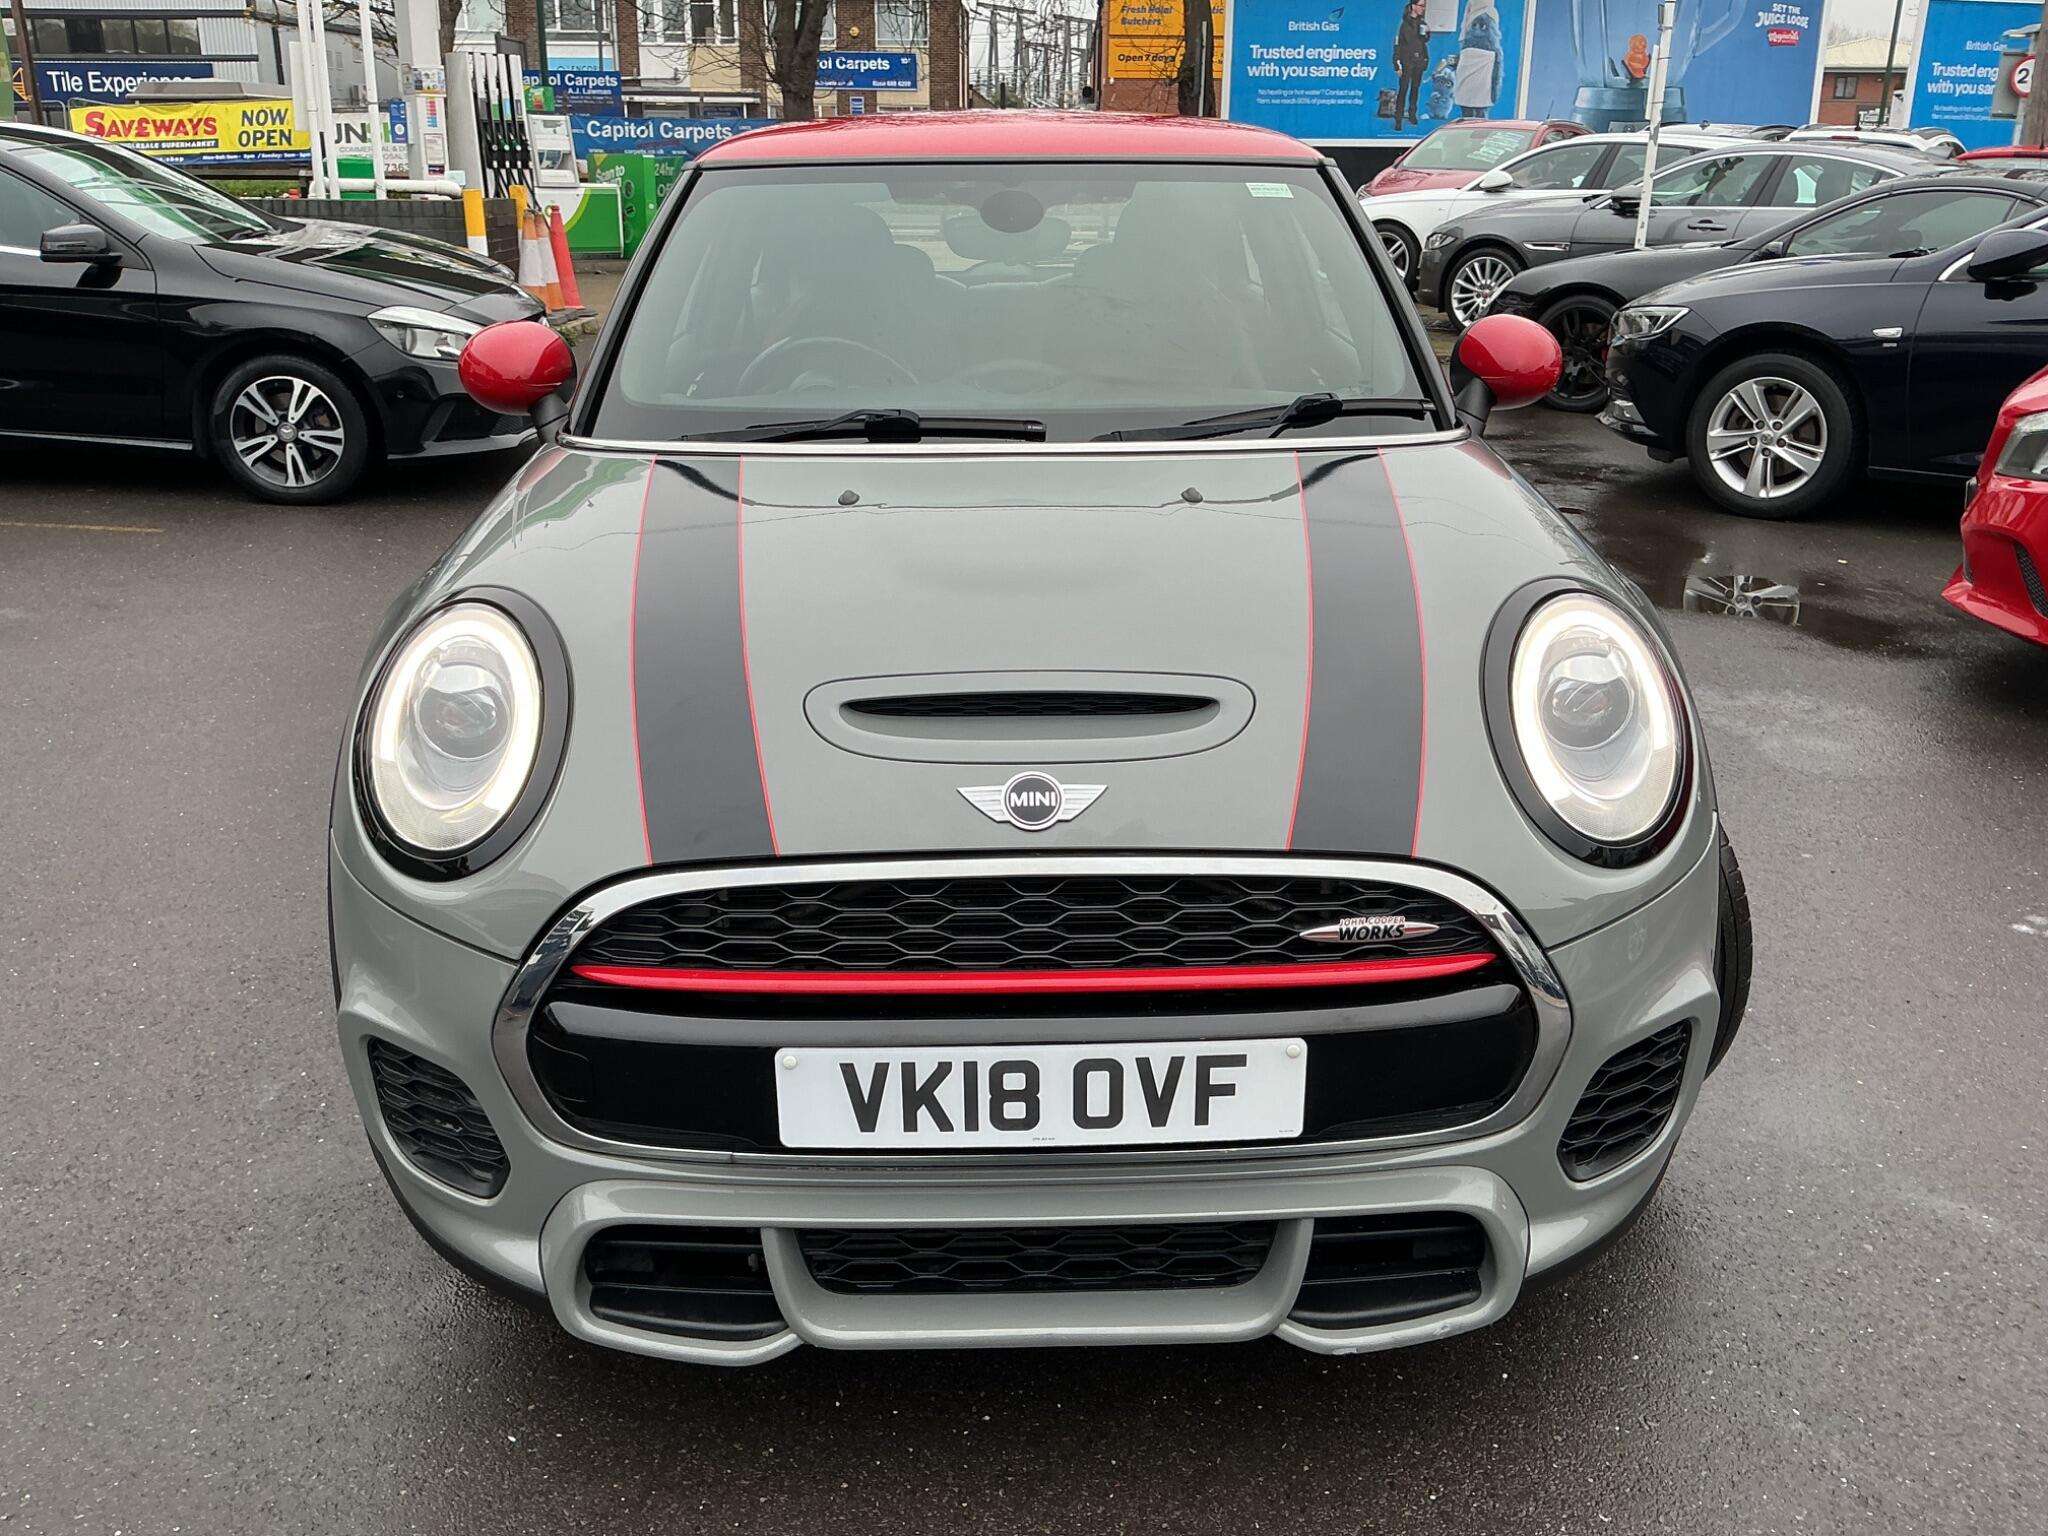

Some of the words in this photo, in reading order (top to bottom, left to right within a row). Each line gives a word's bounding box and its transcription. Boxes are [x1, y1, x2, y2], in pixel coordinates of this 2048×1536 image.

[1773, 3, 1787, 13] SET
[1788, 5, 1801, 14] THE
[1288, 21, 1321, 32] British
[1321, 21, 1340, 32] Gas
[1755, 11, 1786, 27] JUICE
[1250, 44, 1304, 60] Trusted
[1306, 44, 1377, 62] engineers
[1966, 40, 1992, 51] British
[836, 57, 890, 73] Carpets
[1117, 53, 1143, 62] Open
[1247, 61, 1279, 78] with
[1281, 65, 1308, 80] you
[1309, 65, 1349, 78] same
[1350, 63, 1377, 80] day
[1932, 62, 1977, 78] Trusted
[1977, 65, 2000, 82] eng
[2017, 68, 2030, 84] 2
[46, 71, 83, 92] Tile
[564, 73, 618, 89] Carpets
[1927, 79, 1954, 94] with
[1955, 83, 1977, 97] you
[241, 108, 289, 127] NOW
[238, 129, 293, 147] OPEN
[587, 120, 654, 142] Capitol
[659, 121, 732, 143] Carpets
[161, 140, 216, 149] SUPERMARKET
[1010, 791, 1057, 807] MINI
[1339, 918, 1365, 927] JOHN
[1367, 916, 1405, 925] COOPER
[1338, 925, 1404, 941] WORKS
[839, 1060, 1039, 1133] VK18
[1073, 1054, 1247, 1131] OVF
